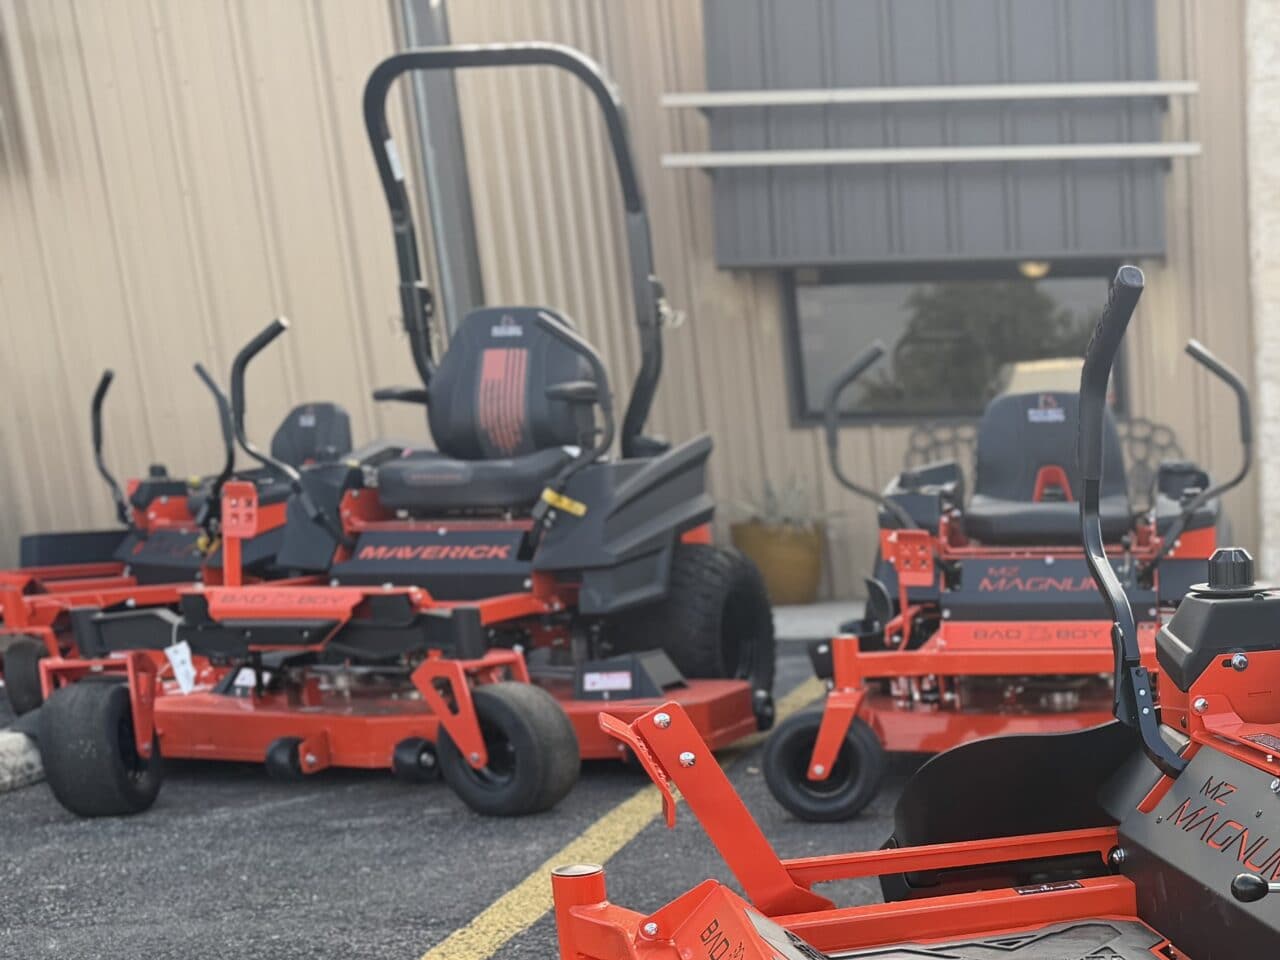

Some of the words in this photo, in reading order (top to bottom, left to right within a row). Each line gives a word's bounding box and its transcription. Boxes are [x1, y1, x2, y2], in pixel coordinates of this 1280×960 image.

[358, 545, 512, 560] MAVERICK
[974, 629, 1022, 640] BAD
[1056, 629, 1102, 640] BOY
[1200, 776, 1238, 806] MZ
